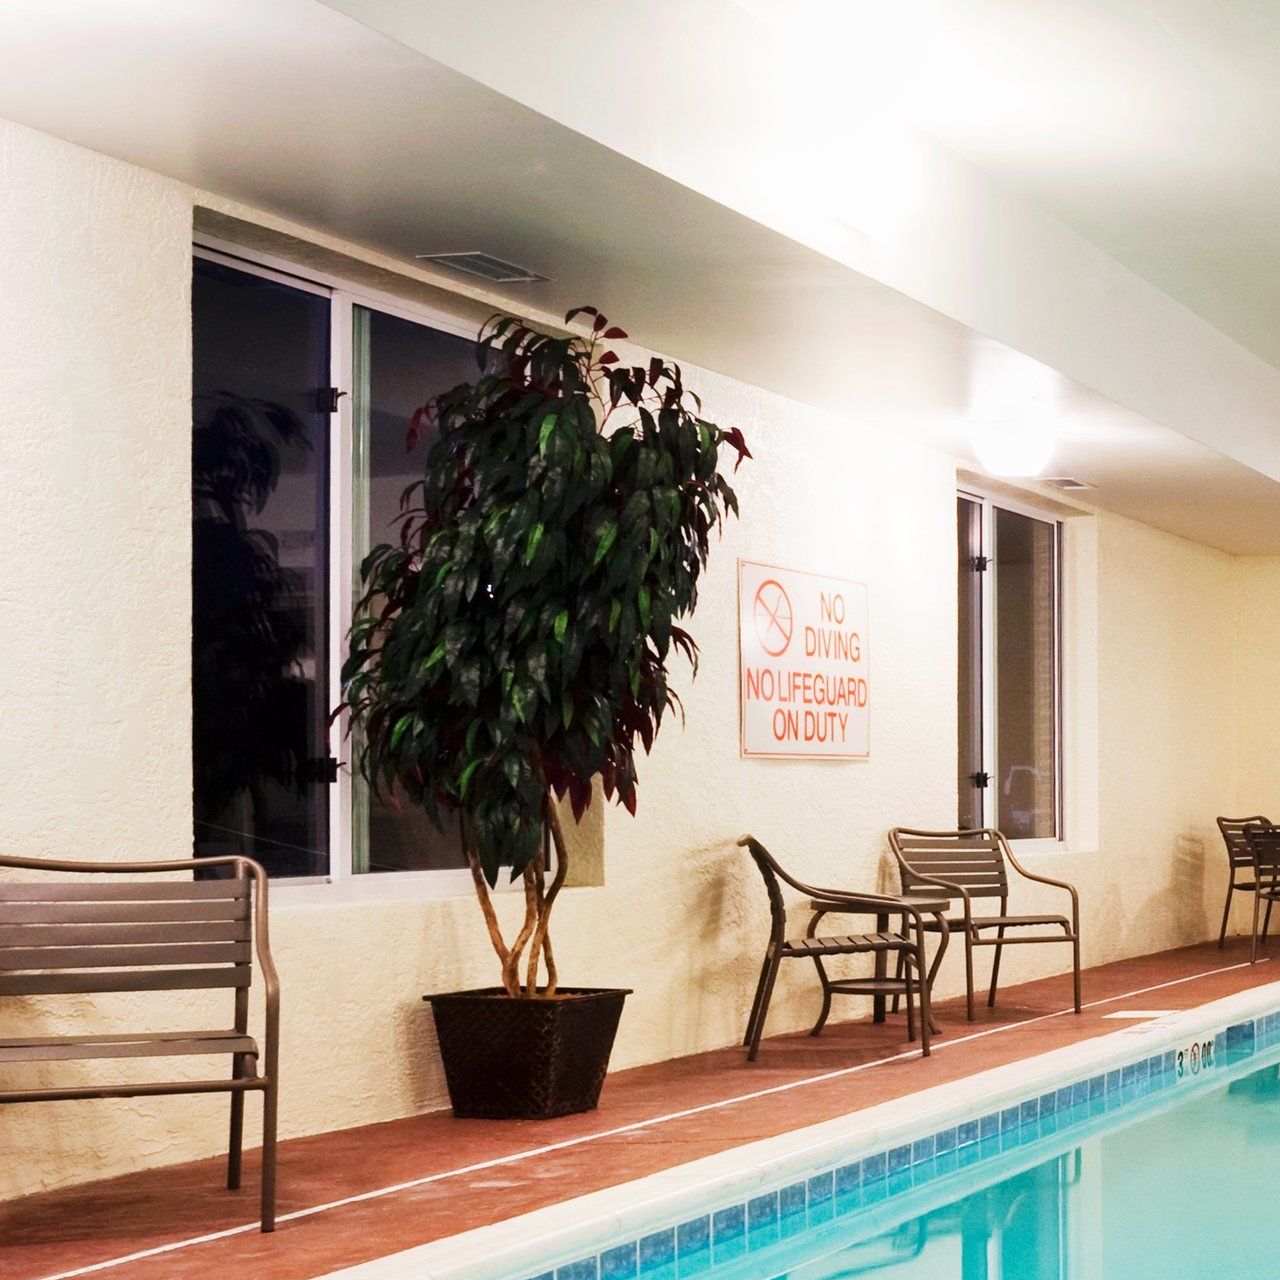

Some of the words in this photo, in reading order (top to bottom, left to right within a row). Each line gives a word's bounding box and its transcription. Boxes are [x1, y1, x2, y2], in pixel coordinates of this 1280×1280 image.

[820, 592, 845, 624] NO
[805, 626, 861, 663] DIVING
[746, 667, 775, 702] NO
[778, 670, 868, 708] LIFEGUARD
[773, 708, 799, 742] ON
[804, 710, 849, 743] DUTY
